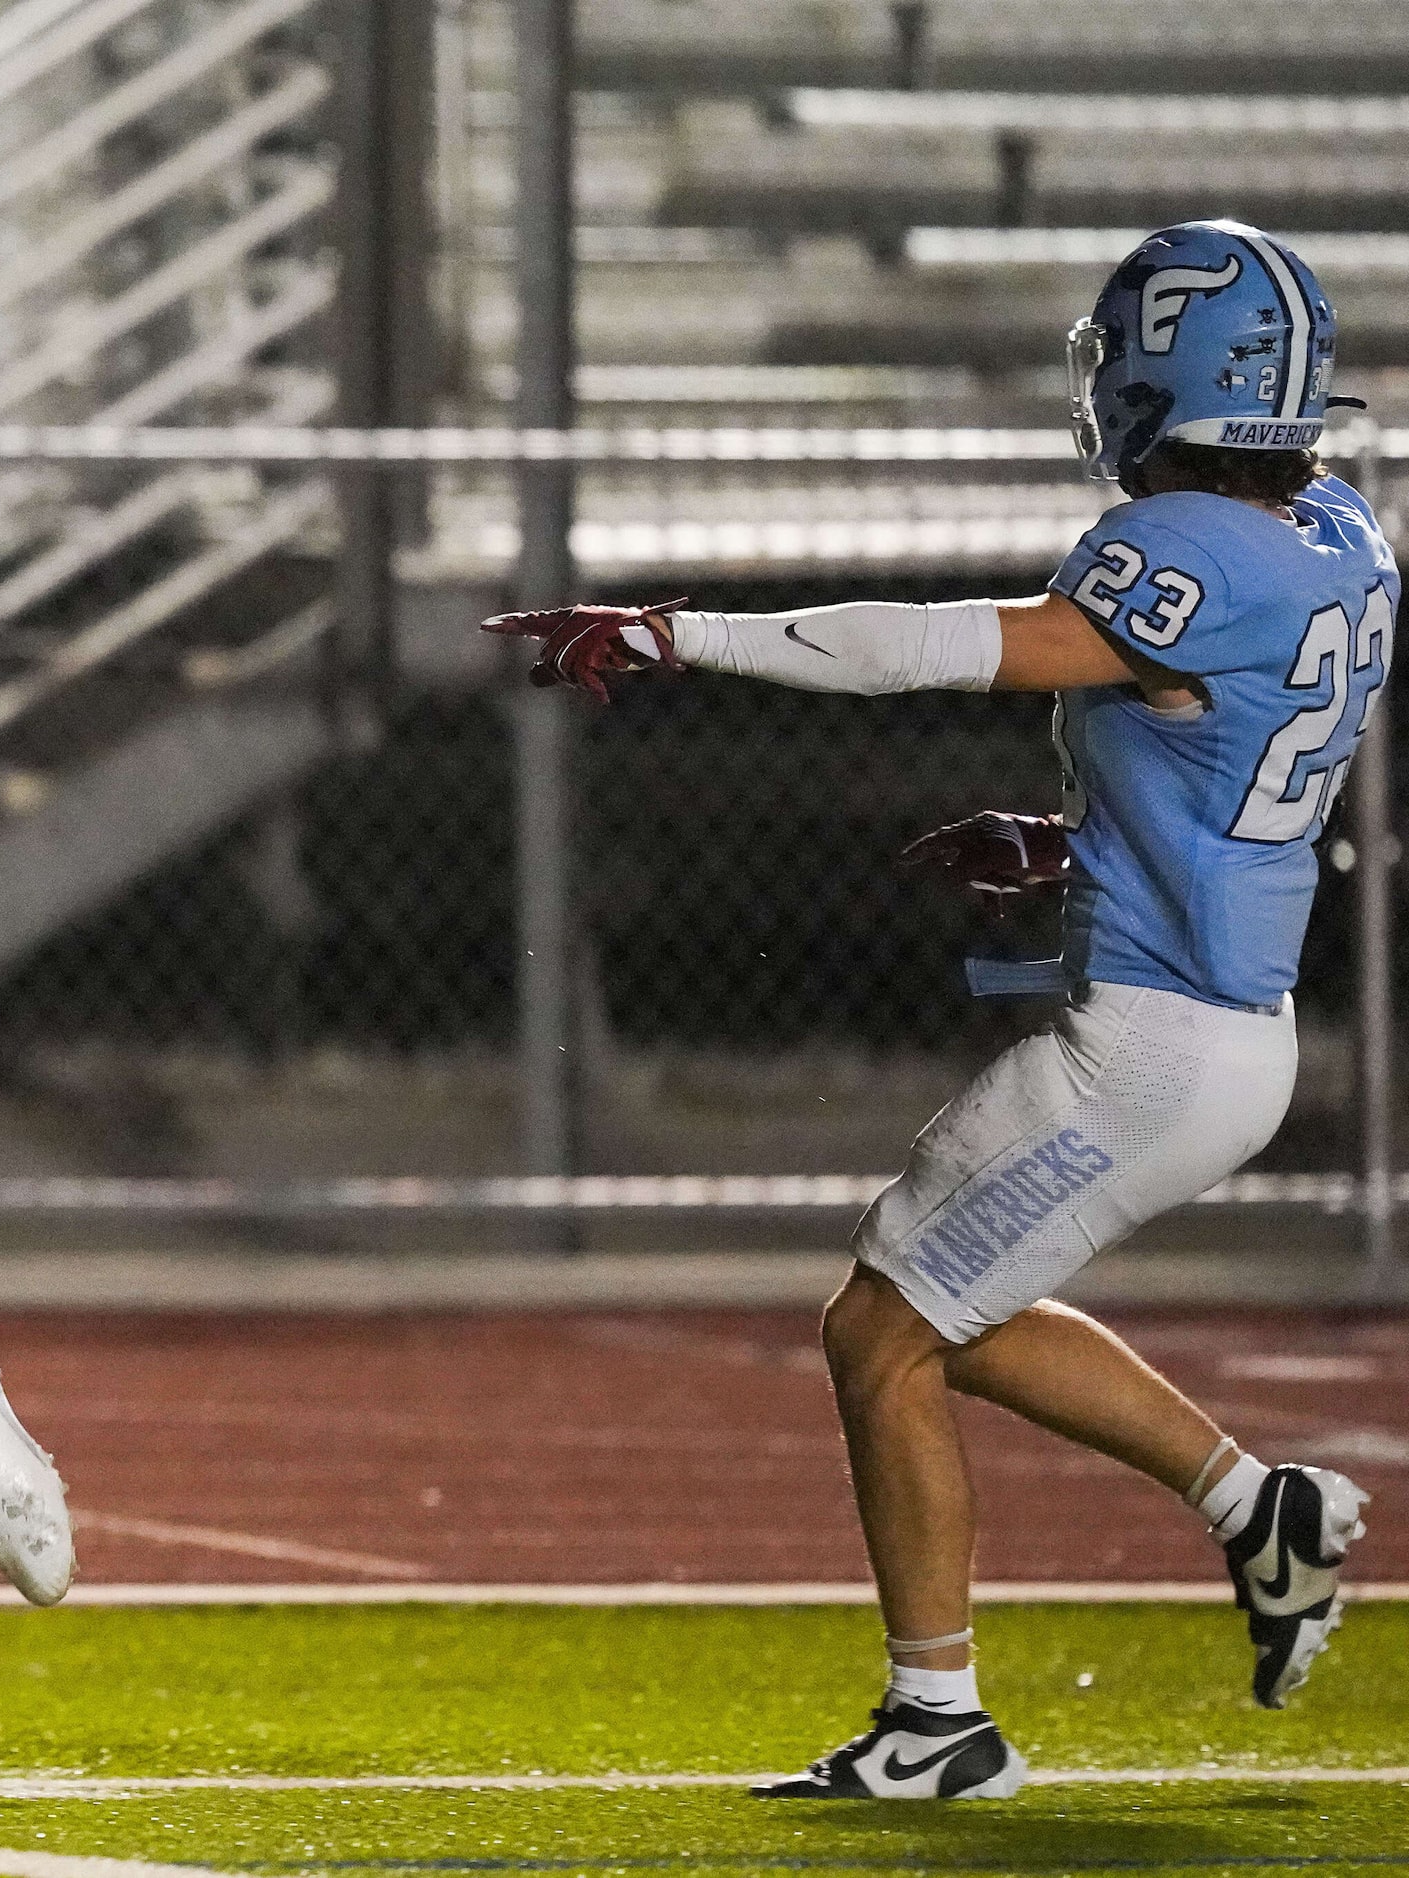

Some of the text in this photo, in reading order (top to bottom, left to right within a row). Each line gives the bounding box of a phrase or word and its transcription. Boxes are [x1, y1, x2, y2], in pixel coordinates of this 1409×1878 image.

[1257, 365, 1278, 402] 2
[1217, 423, 1323, 447] MAVERICK
[1070, 539, 1206, 651] 23
[911, 1128, 1114, 1298] MAVERICKS
